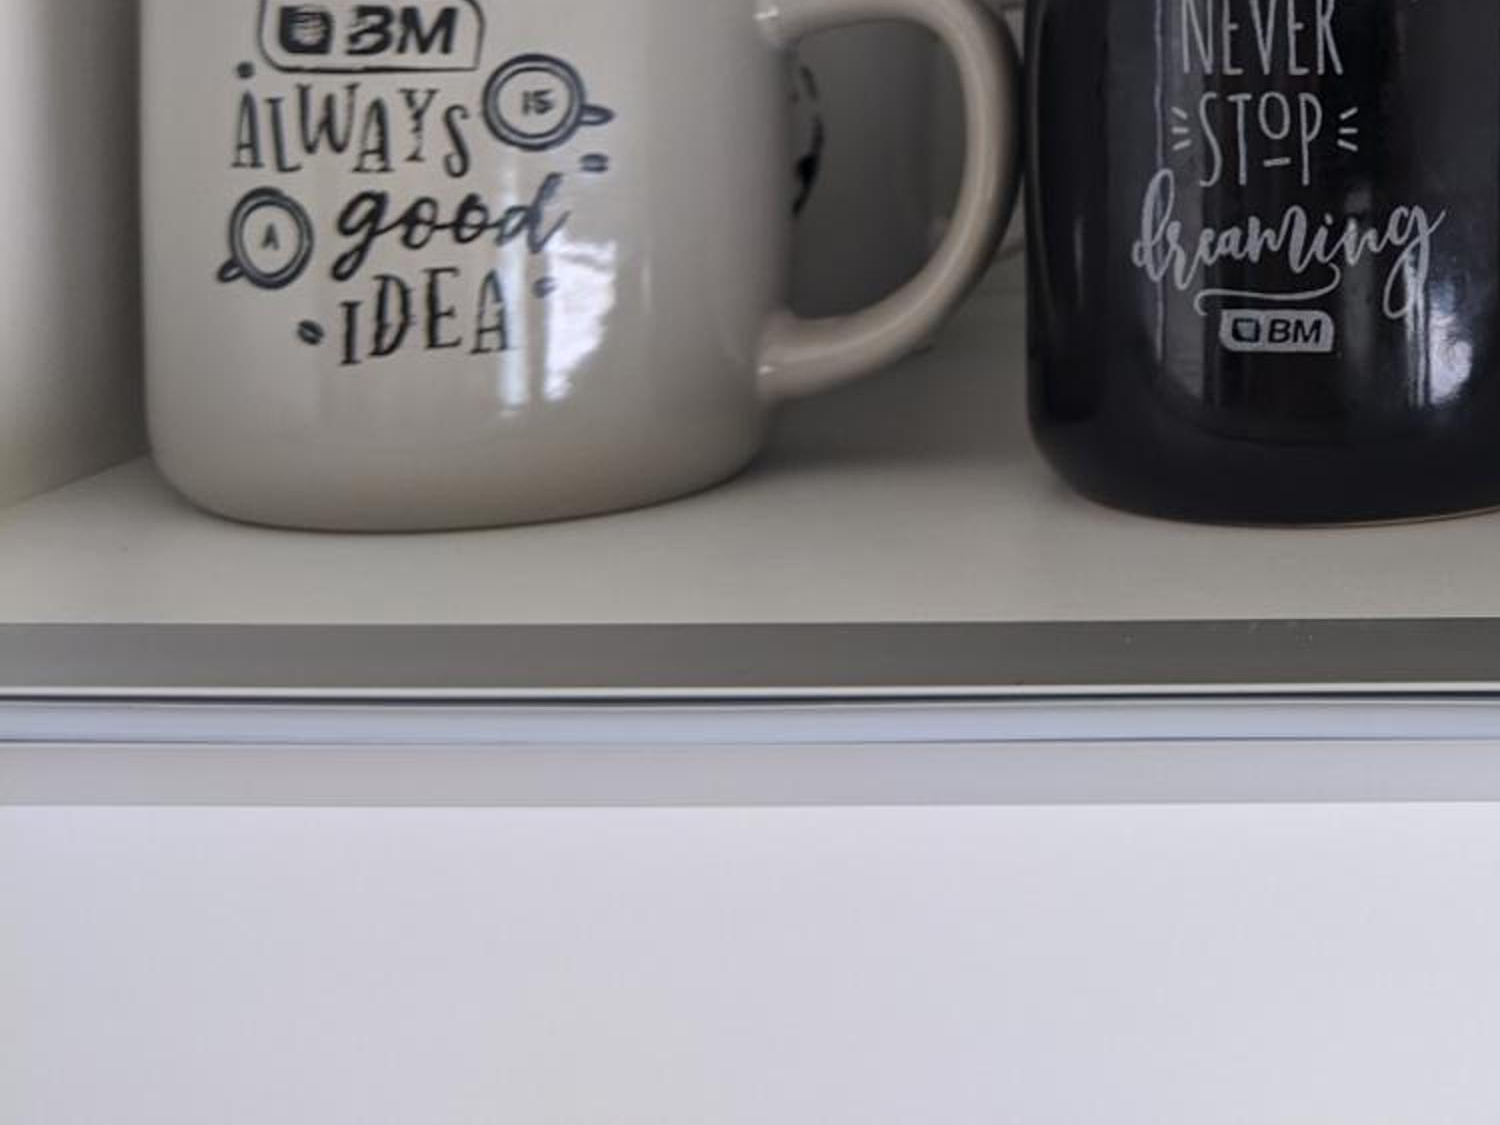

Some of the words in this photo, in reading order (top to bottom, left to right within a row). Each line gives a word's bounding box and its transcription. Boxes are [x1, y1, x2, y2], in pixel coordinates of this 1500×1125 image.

[230, 81, 471, 179] ALWAYS
[1199, 91, 1323, 186] STOP
[261, 223, 281, 251] A
[330, 172, 572, 280] good
[1131, 168, 1446, 319] dreaming
[338, 266, 516, 365] IDEA
[1267, 318, 1323, 344] BM
